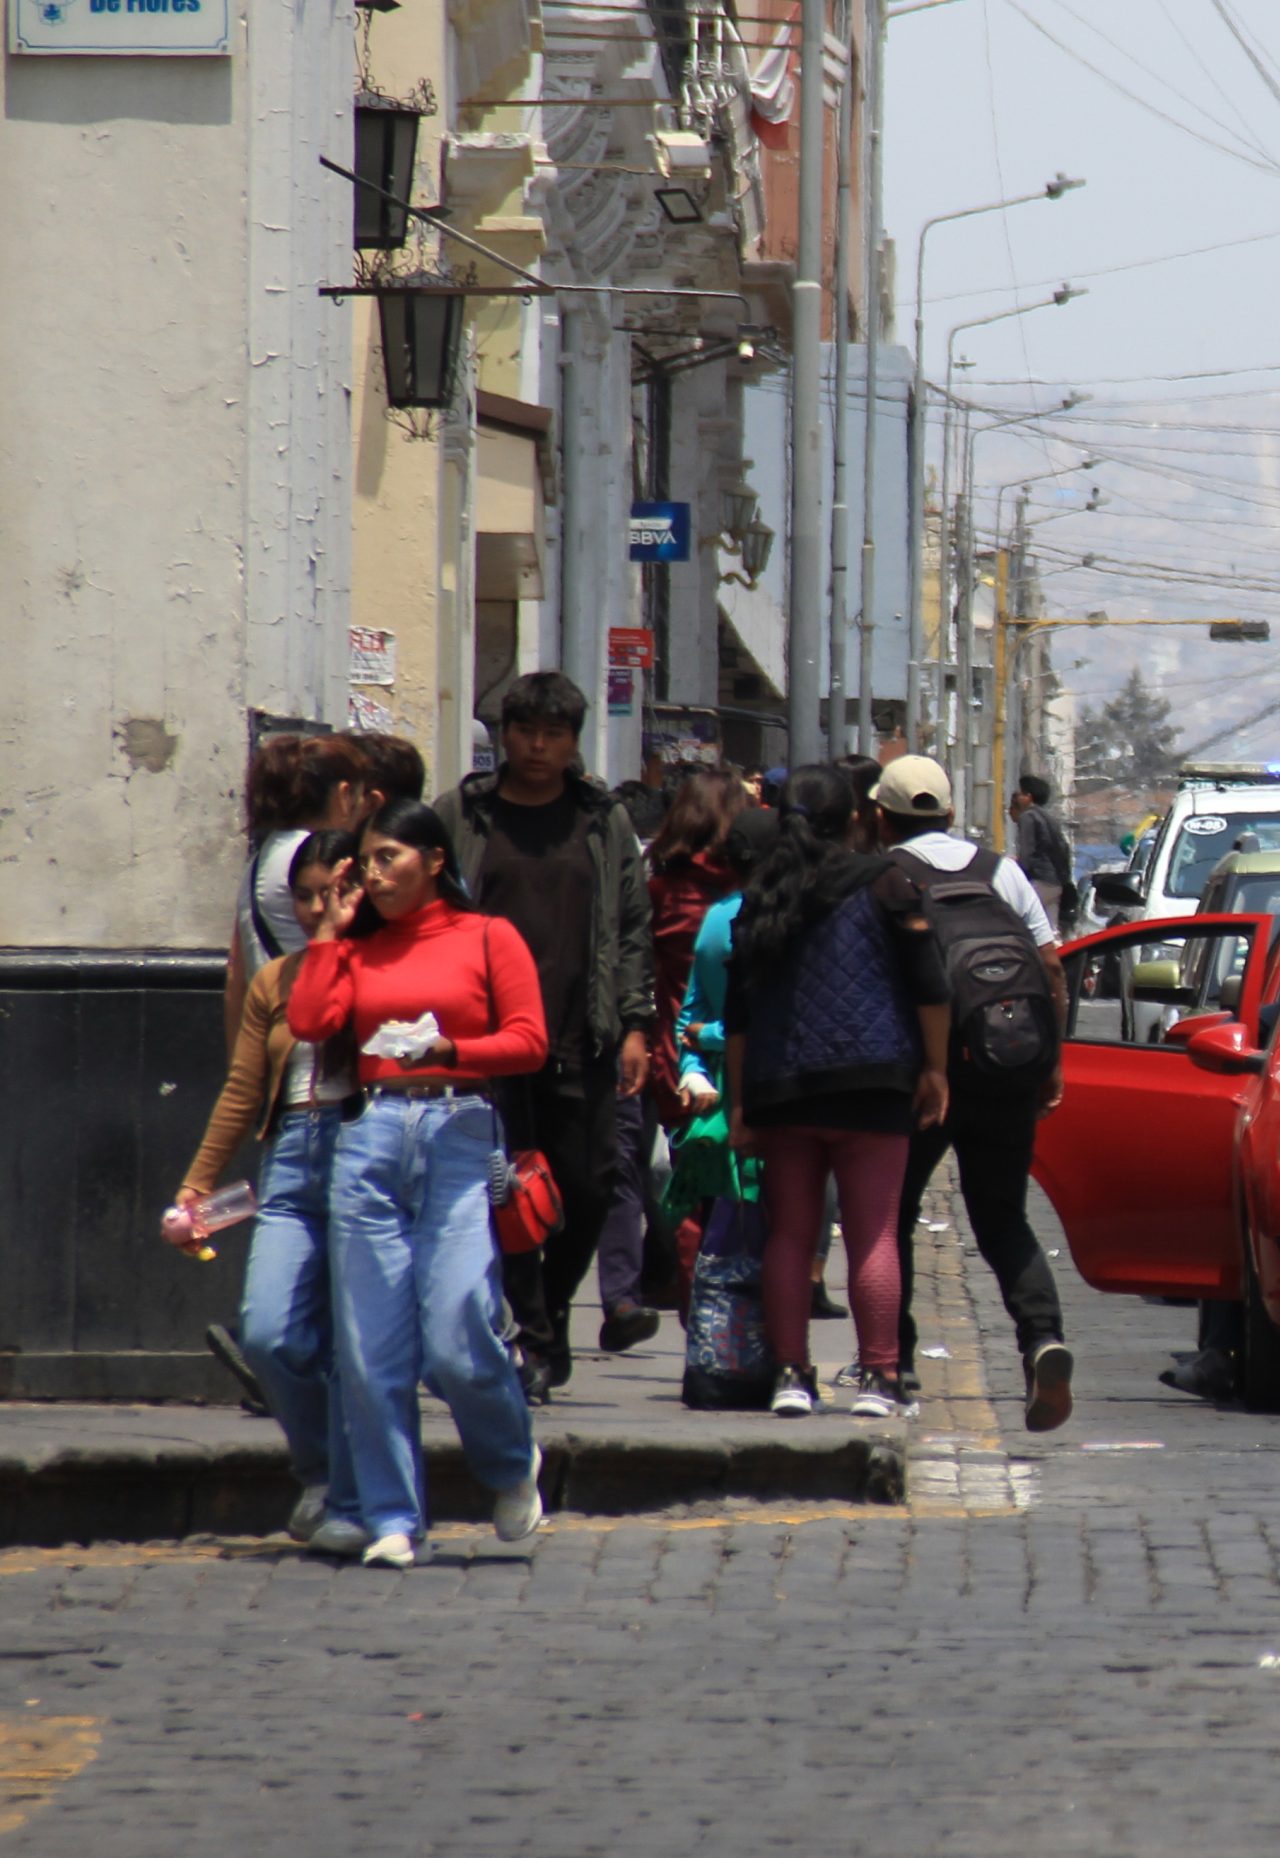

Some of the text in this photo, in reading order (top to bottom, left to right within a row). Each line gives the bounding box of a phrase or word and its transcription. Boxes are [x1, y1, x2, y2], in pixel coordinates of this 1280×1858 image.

[90, 0, 201, 13] De Flores
[629, 531, 677, 545] BBVA
